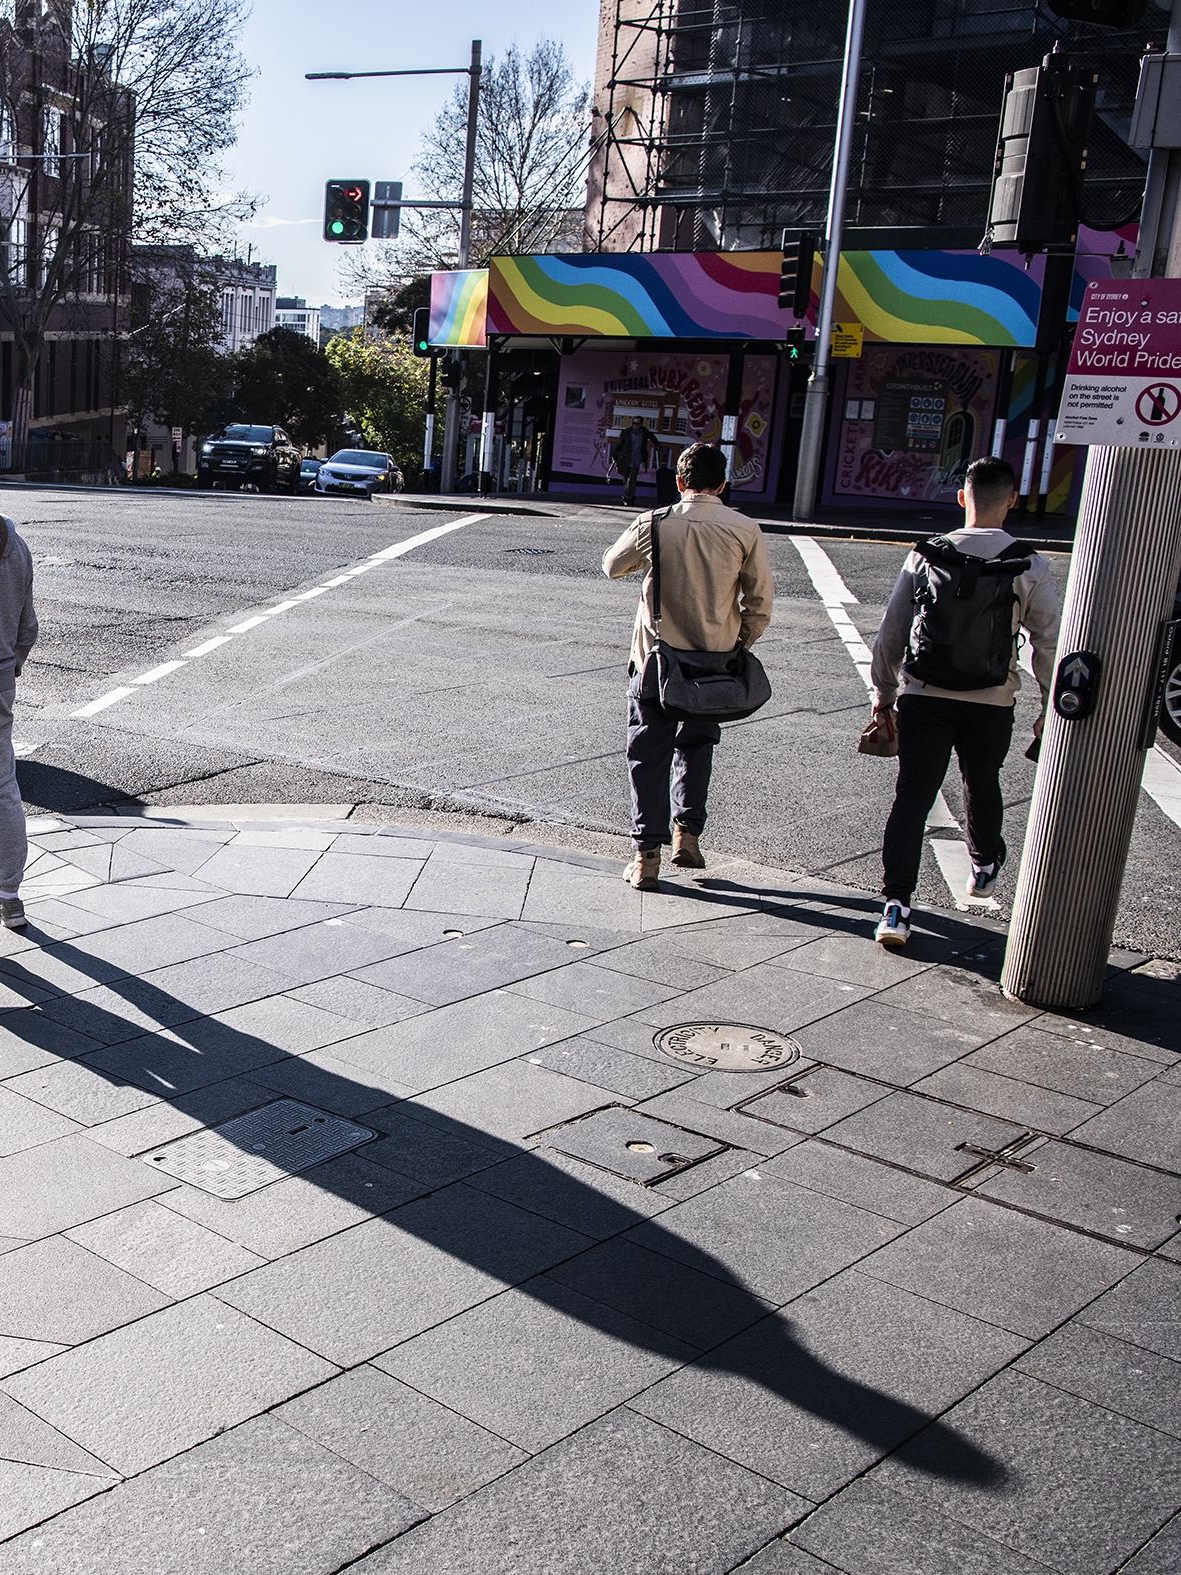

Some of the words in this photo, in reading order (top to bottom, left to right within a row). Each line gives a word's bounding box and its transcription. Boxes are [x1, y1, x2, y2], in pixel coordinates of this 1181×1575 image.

[1085, 307, 1139, 328] Enjoy
[1140, 311, 1152, 324] a
[1155, 311, 1181, 324] sa
[1080, 328, 1151, 350] Sydney
[854, 350, 868, 392] ARMS
[1077, 350, 1129, 367] World
[1134, 352, 1181, 369] Pride
[604, 376, 649, 392] UNIVERSAL
[649, 366, 687, 392] RUBY
[886, 383, 933, 391] GROWTHBUILT
[1071, 384, 1100, 393] Drinking
[1101, 385, 1127, 393] alcohol
[680, 378, 711, 429] REDS
[841, 421, 859, 488] CRICKETE
[1165, 626, 1173, 655] Oxford
[668, 1026, 720, 1066] ELECTRICITY
[750, 1033, 783, 1066] DANGER
